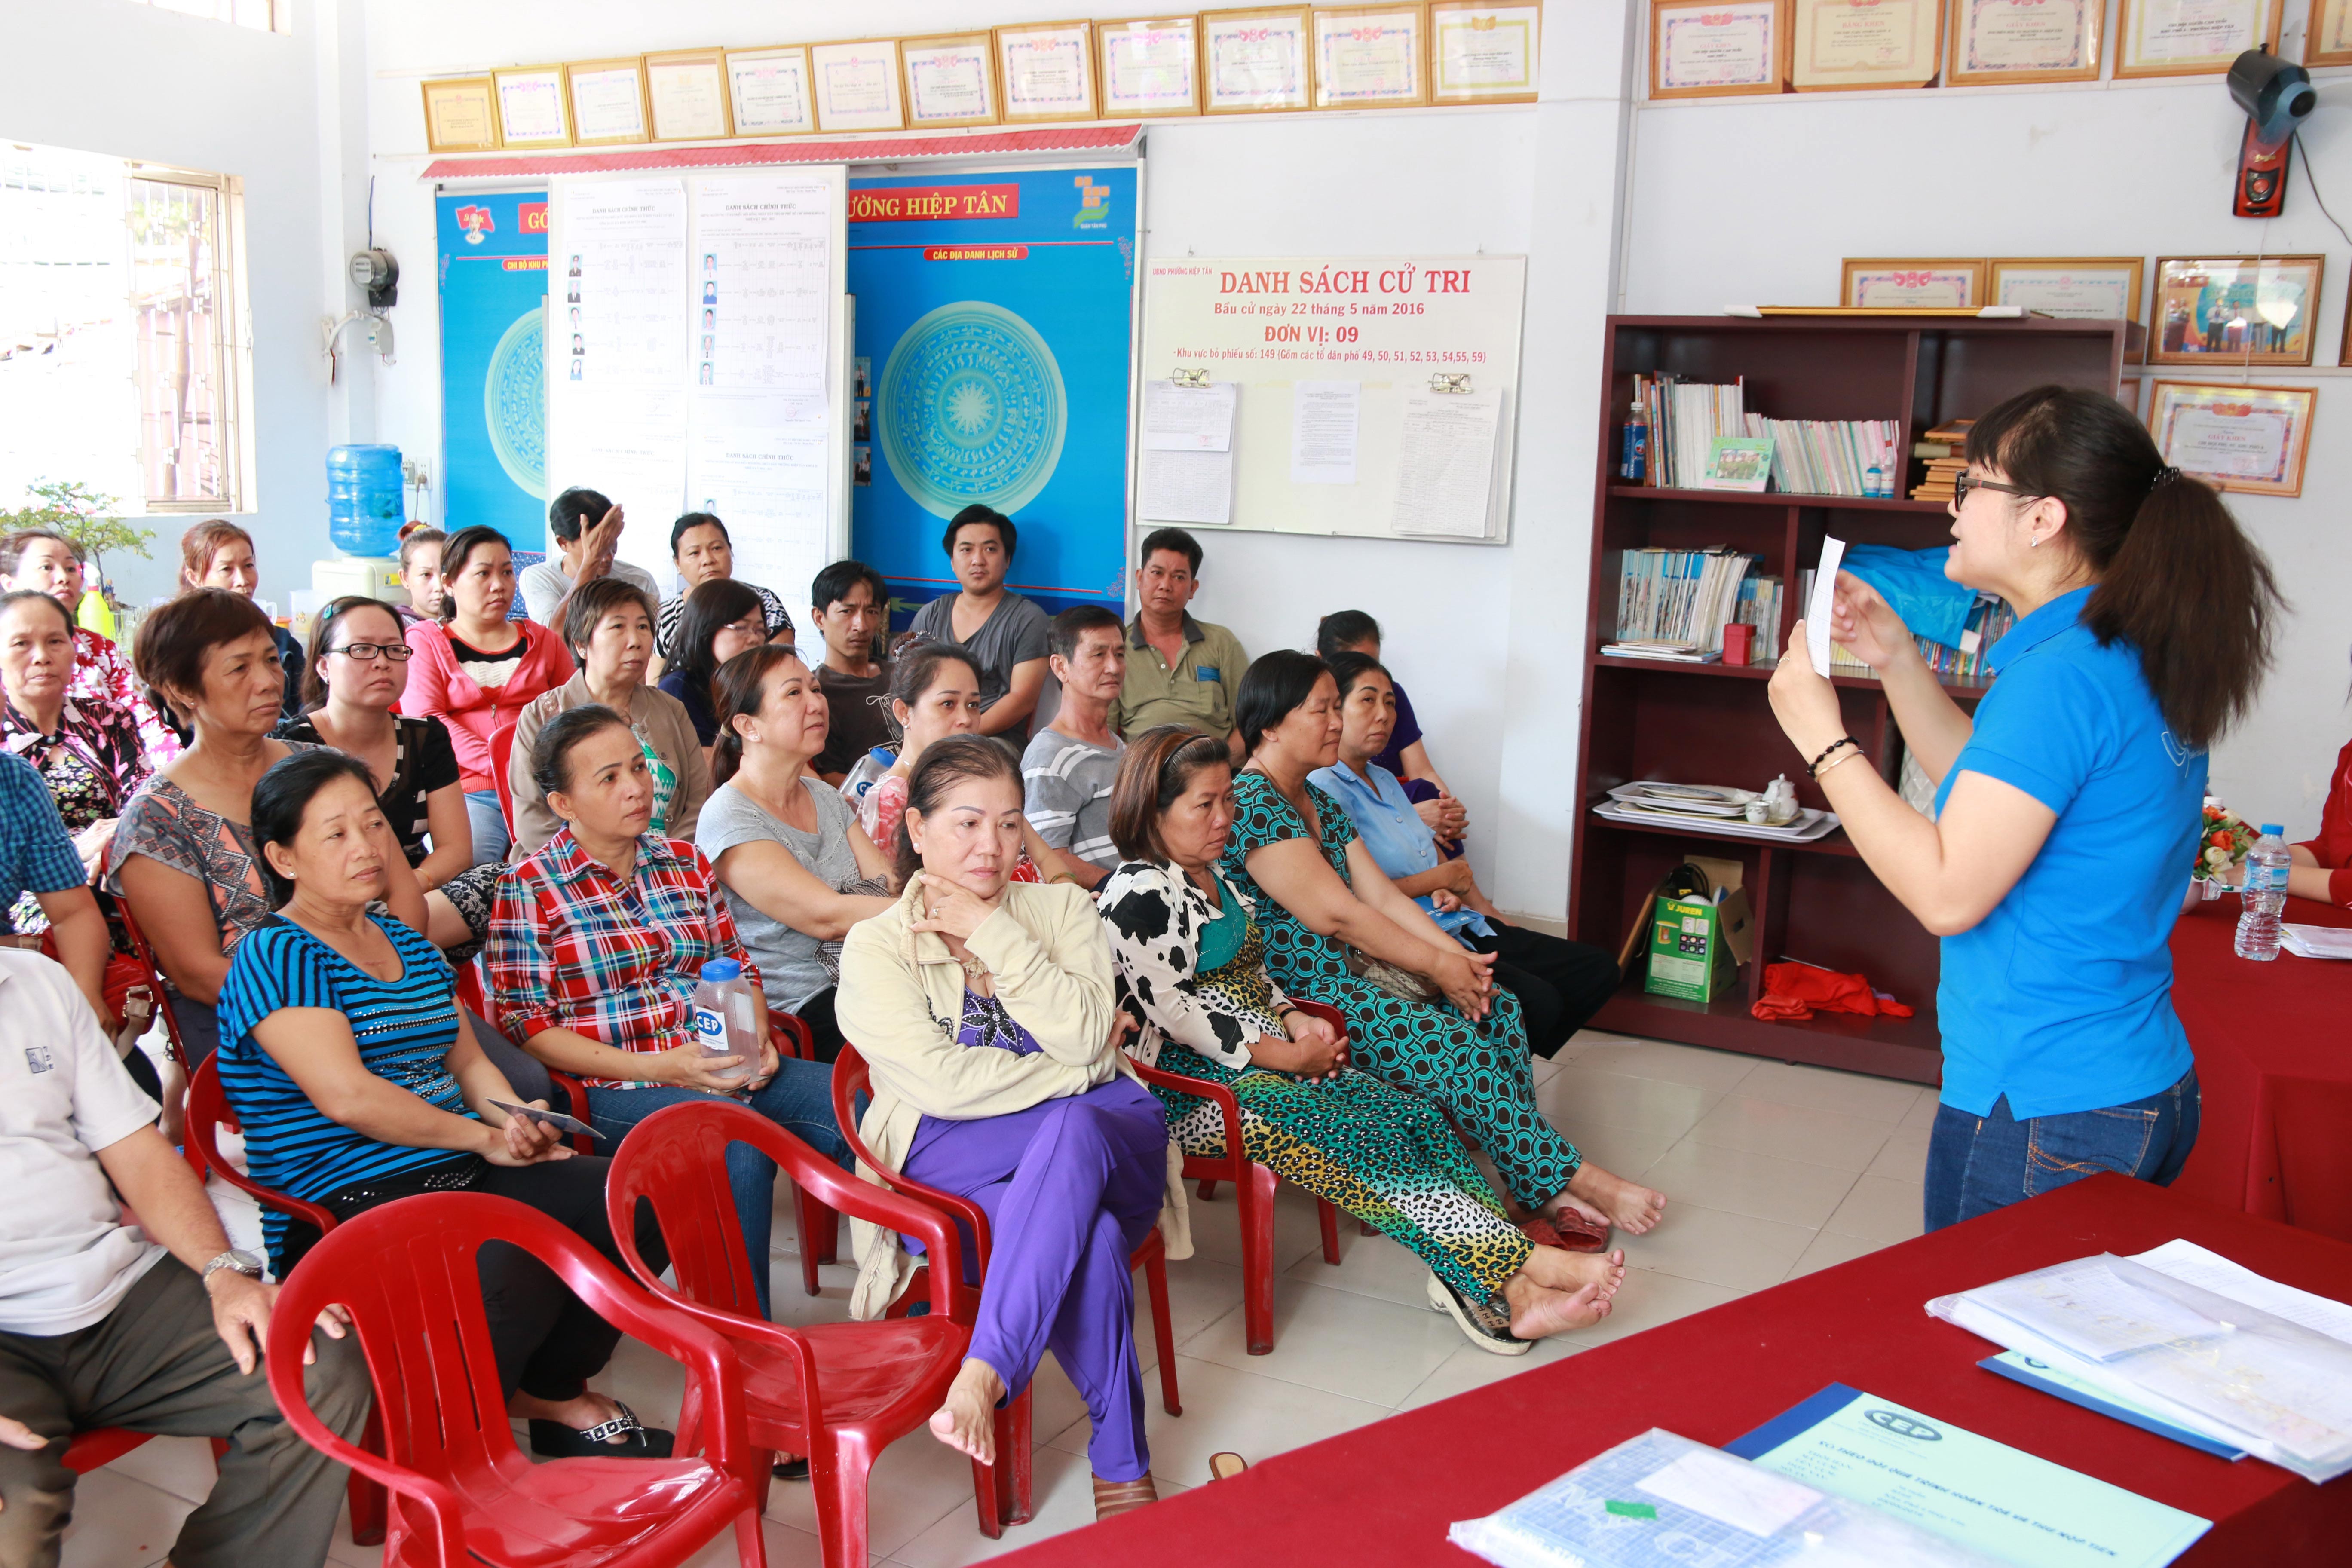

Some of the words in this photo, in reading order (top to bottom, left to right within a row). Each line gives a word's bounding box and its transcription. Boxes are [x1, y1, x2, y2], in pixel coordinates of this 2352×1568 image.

[849, 194, 900, 217] ƯỜNG
[906, 192, 958, 219] HIỆP
[963, 190, 1008, 214] TÂN
[528, 207, 548, 229] GÓ
[933, 249, 948, 260] CÁC
[949, 249, 963, 261] ĐỊA
[965, 250, 985, 260] DANH
[988, 249, 1005, 261] LỊCH
[1008, 247, 1018, 258] SỬ
[508, 261, 518, 270] CHI
[519, 259, 527, 270] BỘ
[528, 260, 541, 269] KHU
[1168, 266, 1188, 276] PHƯỜNG
[1189, 267, 1200, 277] HIỆP
[1202, 266, 1212, 275] TÂN
[1220, 271, 1290, 293] DANH
[1299, 264, 1370, 294] SÁCH
[1379, 262, 1416, 294] CỬ
[1424, 270, 1471, 293] TRI
[1241, 301, 1256, 314] cử
[1259, 303, 1287, 317] ngày
[1291, 303, 1307, 314] 22
[1311, 303, 1344, 317] tháng
[1350, 303, 1357, 315] 5
[1362, 303, 1387, 315] năm
[1392, 303, 1424, 315] 2016
[1265, 323, 1301, 342] ĐƠN
[1308, 326, 1329, 346] VỊ:
[1336, 326, 1359, 343] 09
[1194, 349, 1207, 360] vực
[1210, 348, 1219, 358] bỏ
[1222, 346, 1243, 360] phiếu
[1246, 347, 1257, 359] số:
[1260, 349, 1275, 359] 149
[1300, 349, 1314, 360] các
[1317, 346, 1325, 360] tổ
[1327, 349, 1341, 361] dân
[1344, 348, 1361, 362] phố
[1362, 350, 1375, 363] 49,
[1378, 350, 1391, 363] 50,
[1394, 350, 1407, 364] 51,
[1410, 351, 1423, 364] 52,
[1426, 351, 1439, 364] 53,
[1675, 905, 1703, 916] JUREN
[697, 1015, 718, 1032] CEP
[1872, 1412, 1935, 1438] CEP
